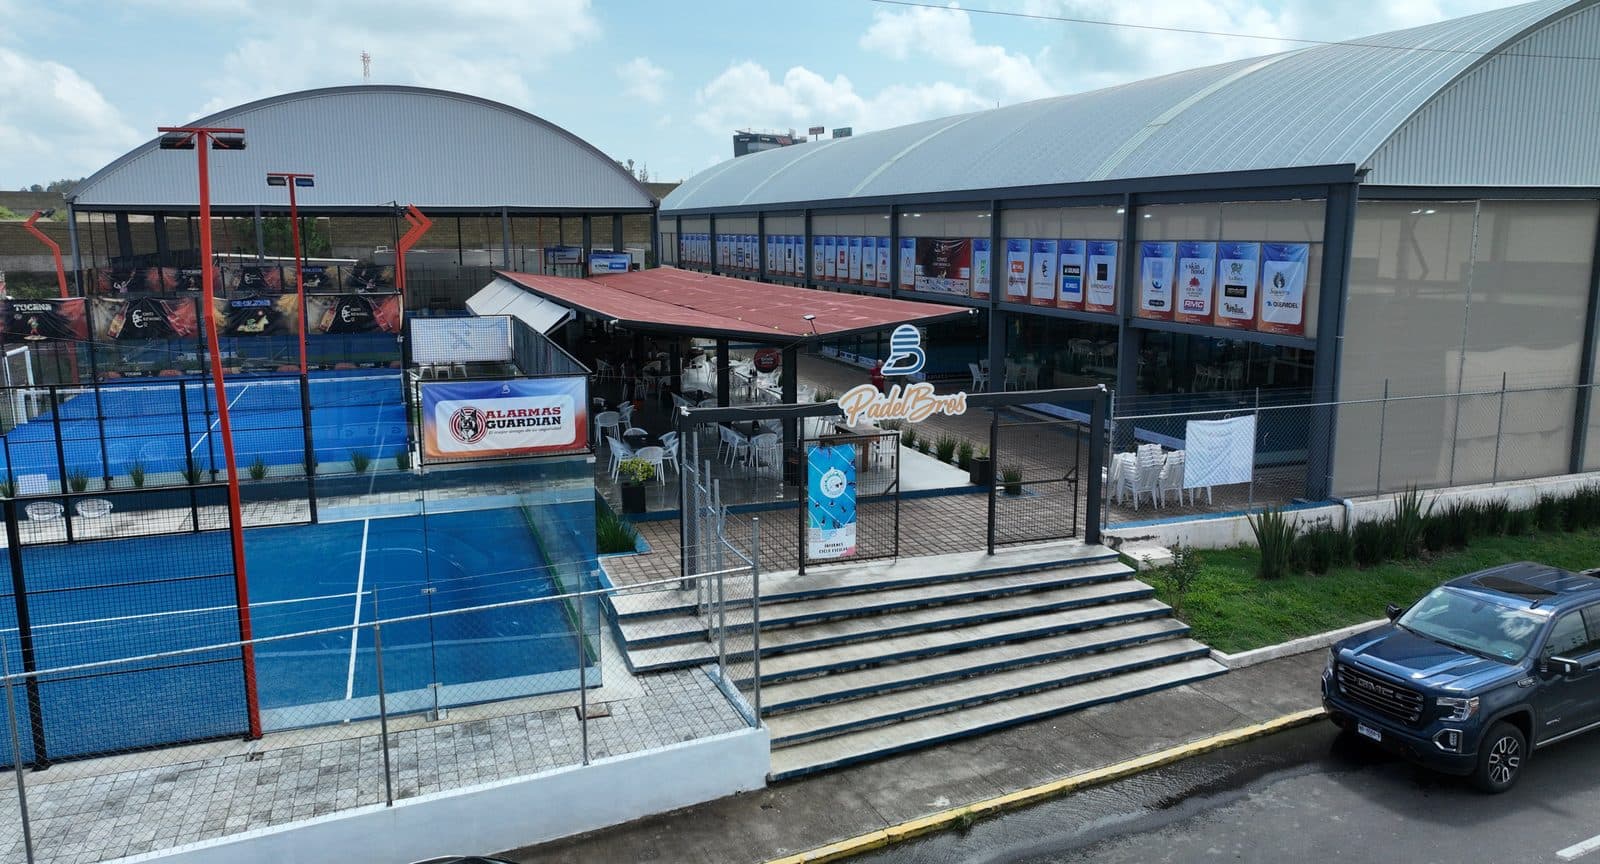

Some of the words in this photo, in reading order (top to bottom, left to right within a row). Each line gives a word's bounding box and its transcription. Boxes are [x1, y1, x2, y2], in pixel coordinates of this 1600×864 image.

[486, 407, 561, 419] ALARMAS
[486, 416, 562, 430] GUARDIAN
[1358, 678, 1394, 698] GMC
